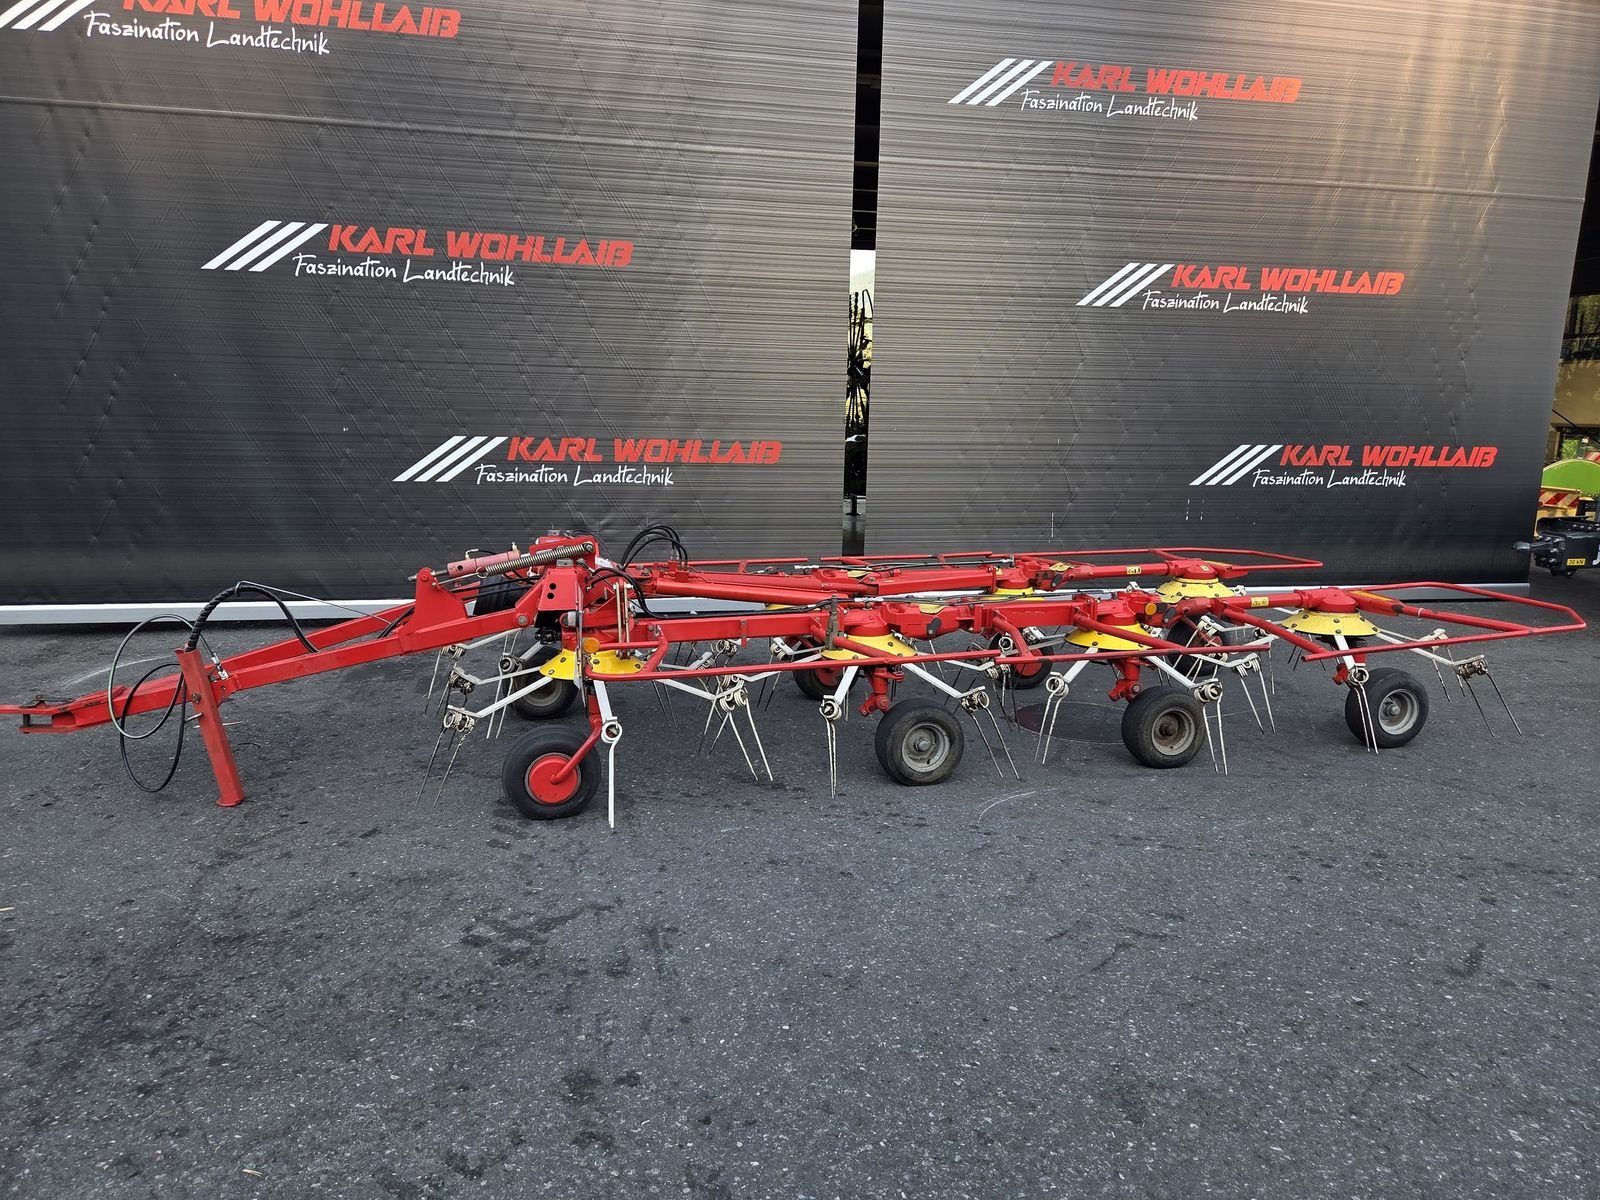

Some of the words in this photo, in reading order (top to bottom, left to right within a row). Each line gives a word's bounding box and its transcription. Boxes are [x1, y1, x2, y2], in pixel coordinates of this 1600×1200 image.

[85, 11, 199, 42] Faszination
[207, 21, 329, 55] Landtechnik
[253, 0, 461, 37] WOHLLAIB
[1052, 63, 1136, 92] KARL
[1146, 68, 1303, 103] WOHLLAIB
[1020, 88, 1102, 112] Faszination
[1107, 95, 1198, 121] Landtechnik
[329, 224, 434, 256] KARL
[447, 231, 634, 267] WOHLLAIB
[293, 252, 396, 277] Faszination
[403, 259, 514, 286] Landtechnik
[1171, 264, 1251, 290] KARL
[1260, 267, 1405, 295] WOHLLAIB
[1142, 290, 1219, 311] Faszination
[1223, 293, 1308, 314] Landtechnik
[507, 437, 602, 462] KARL
[614, 438, 782, 464] WOHLLAIB
[1280, 445, 1352, 467] KARL
[1362, 445, 1498, 467] WOHLLAIB
[474, 463, 567, 485] Faszination
[574, 465, 673, 486] Landtechnik
[1252, 468, 1323, 488] Faszination
[1327, 469, 1406, 488] Landtechnik
